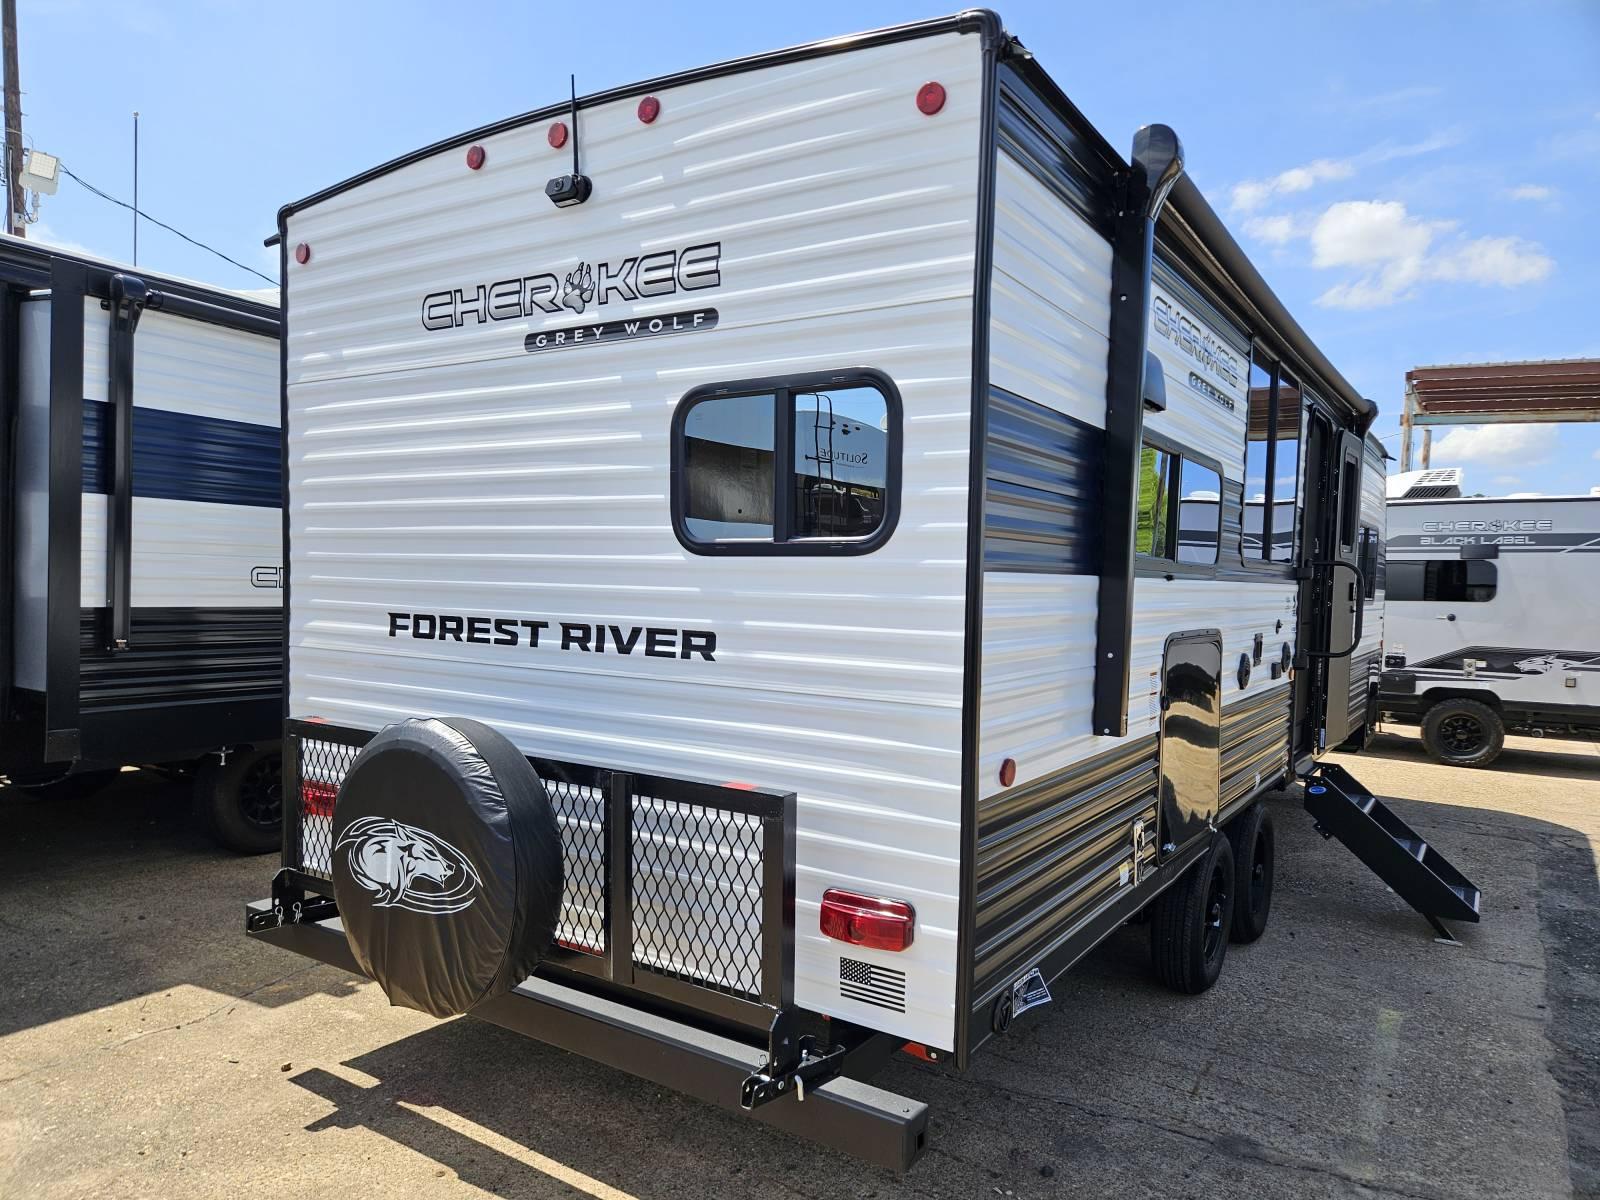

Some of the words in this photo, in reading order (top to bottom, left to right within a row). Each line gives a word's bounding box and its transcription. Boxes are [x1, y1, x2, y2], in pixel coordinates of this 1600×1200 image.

[535, 325, 604, 347] GREY
[624, 312, 706, 336] WOLF
[1420, 536, 1476, 545] BLACK
[1480, 535, 1536, 545] LABEL
[250, 566, 284, 588] C
[387, 612, 549, 649] FOREST
[559, 622, 717, 662] RIVER
